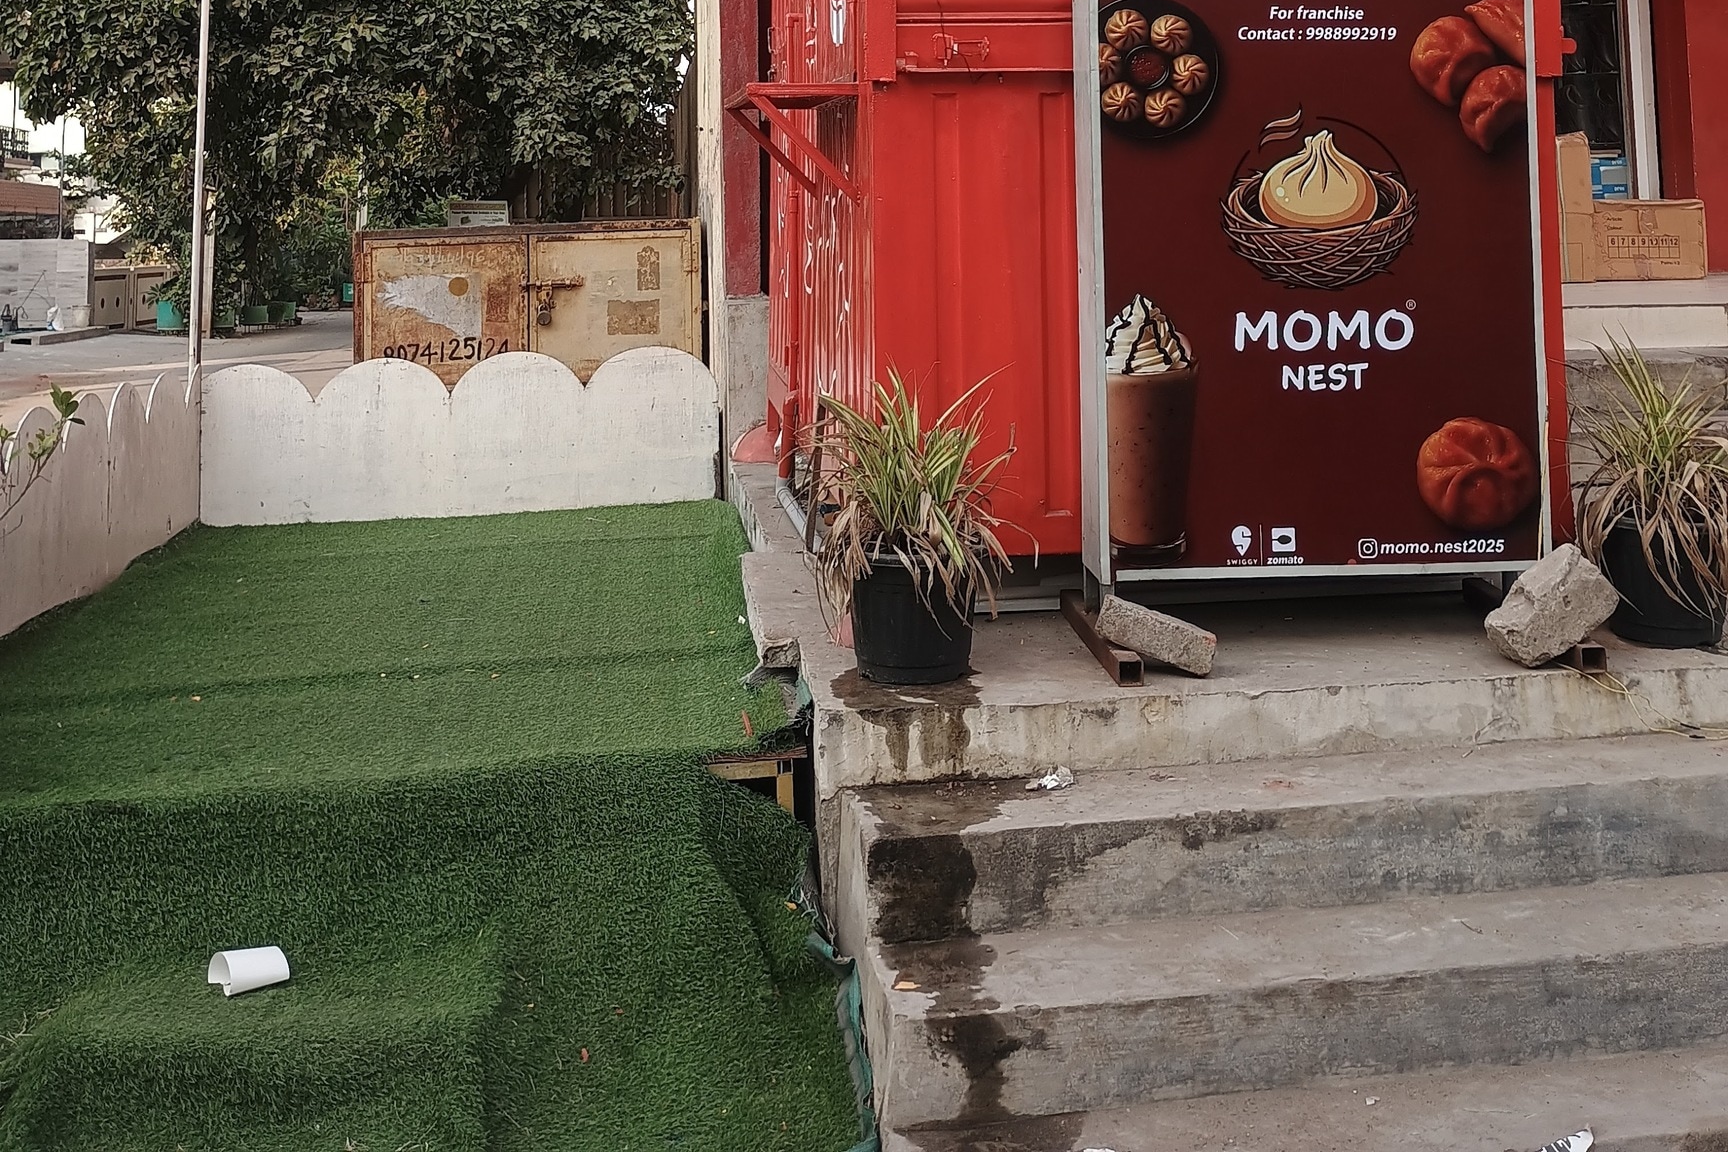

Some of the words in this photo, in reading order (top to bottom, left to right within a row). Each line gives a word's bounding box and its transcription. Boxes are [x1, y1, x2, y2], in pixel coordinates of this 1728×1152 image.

[1269, 5, 1294, 20] For
[1296, 5, 1364, 20] franchise
[1237, 26, 1295, 41] Contact
[1305, 26, 1397, 41] 9988992919
[1610, 237, 1616, 246] 6
[1619, 237, 1626, 246] 7
[1630, 237, 1636, 246] 8
[1640, 237, 1646, 246] 9
[1649, 237, 1659, 246] 10
[1660, 237, 1668, 246] 11
[1669, 237, 1679, 246] 12
[1234, 308, 1415, 352] MOMO
[1281, 362, 1369, 392] NEST
[1380, 539, 1505, 554] momo.nest2025
[1226, 558, 1258, 566] SWIGGY
[1266, 555, 1304, 565] zomato
